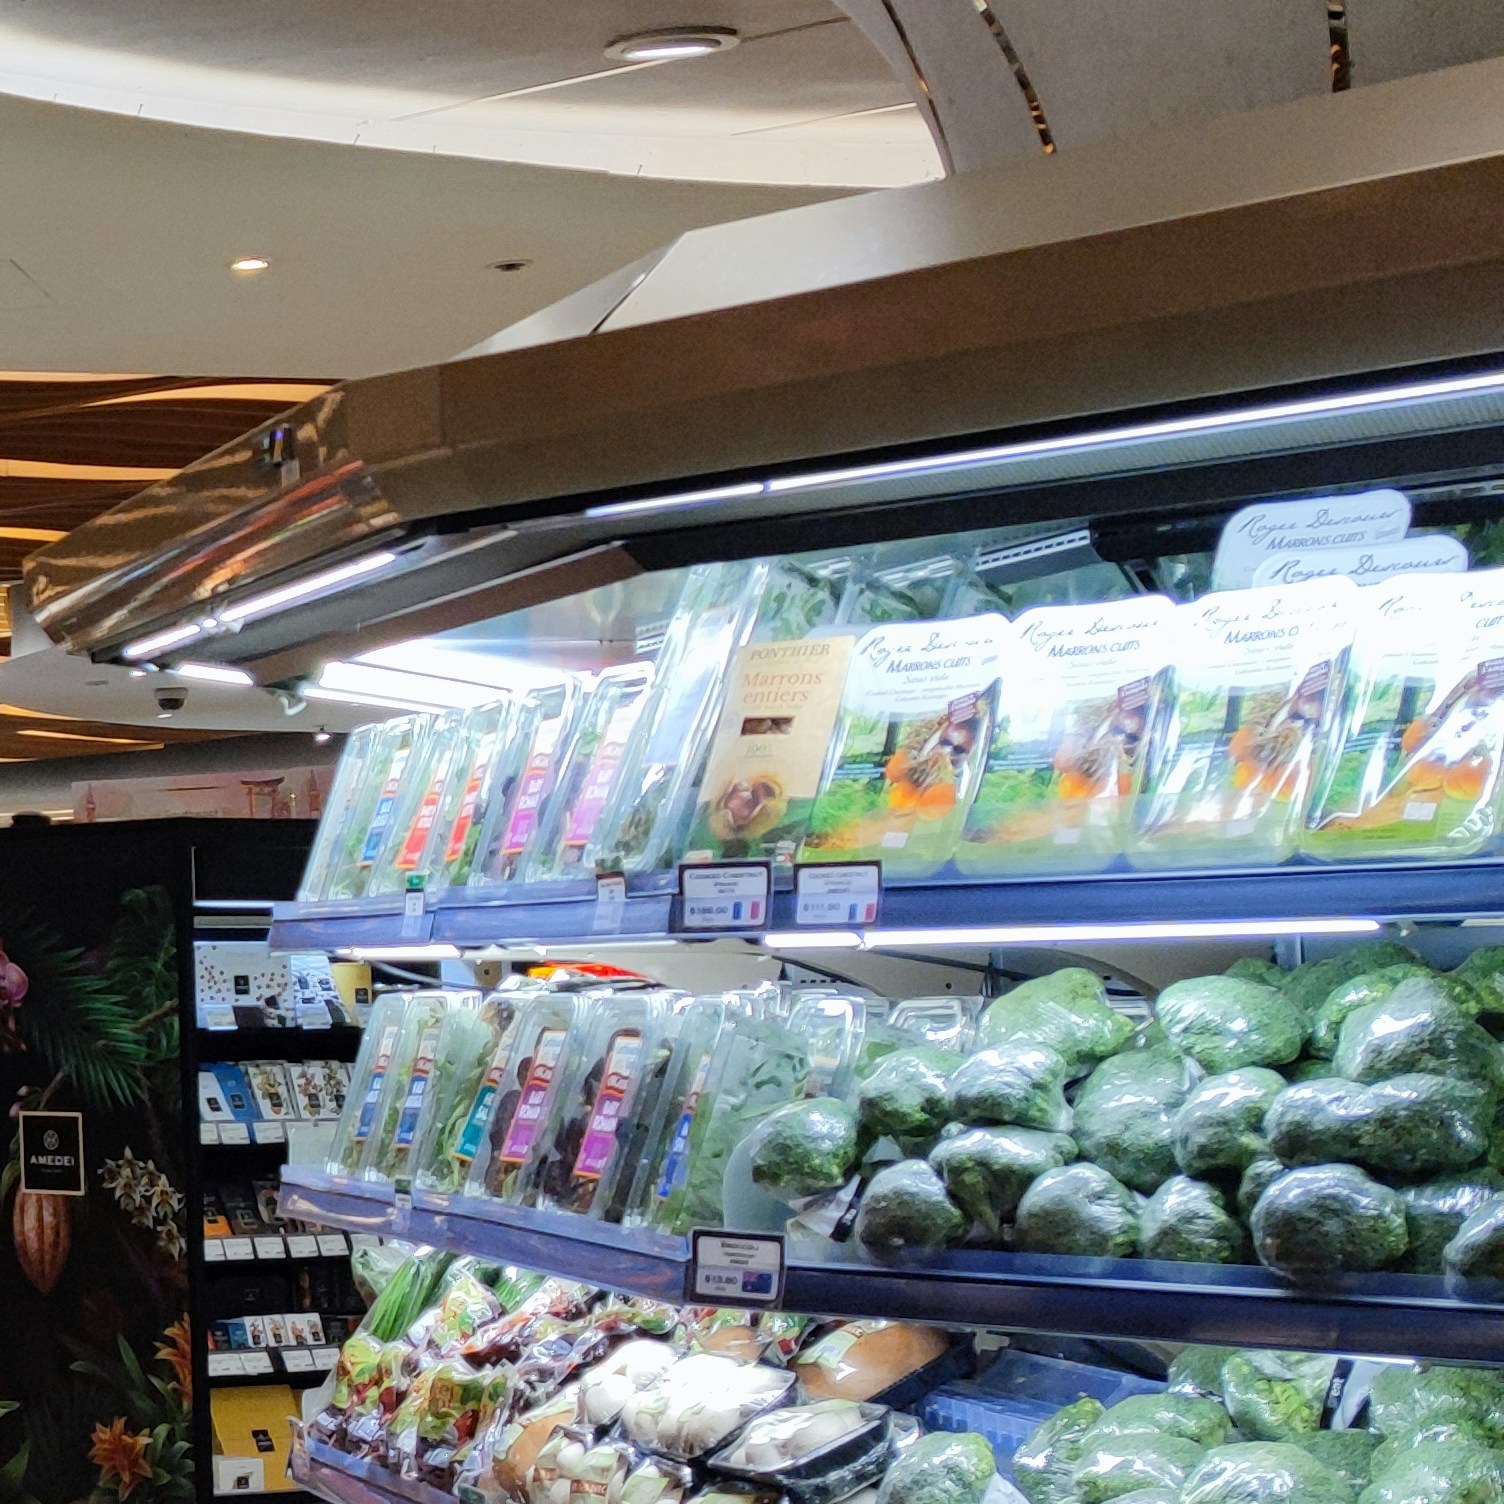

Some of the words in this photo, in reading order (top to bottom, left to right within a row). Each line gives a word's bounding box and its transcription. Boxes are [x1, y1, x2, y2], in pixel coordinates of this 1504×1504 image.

[1238, 514, 1296, 544] Roger
[1266, 532, 1336, 550] MARRONS
[1270, 559, 1339, 583] Roger
[749, 644, 831, 661] PONTHIER
[1047, 644, 1107, 658] MARRONS
[886, 659, 940, 674] MARRONS
[743, 672, 823, 687] Marrons
[743, 688, 809, 704] entiers
[30, 1155, 74, 1166] AMEDEI
